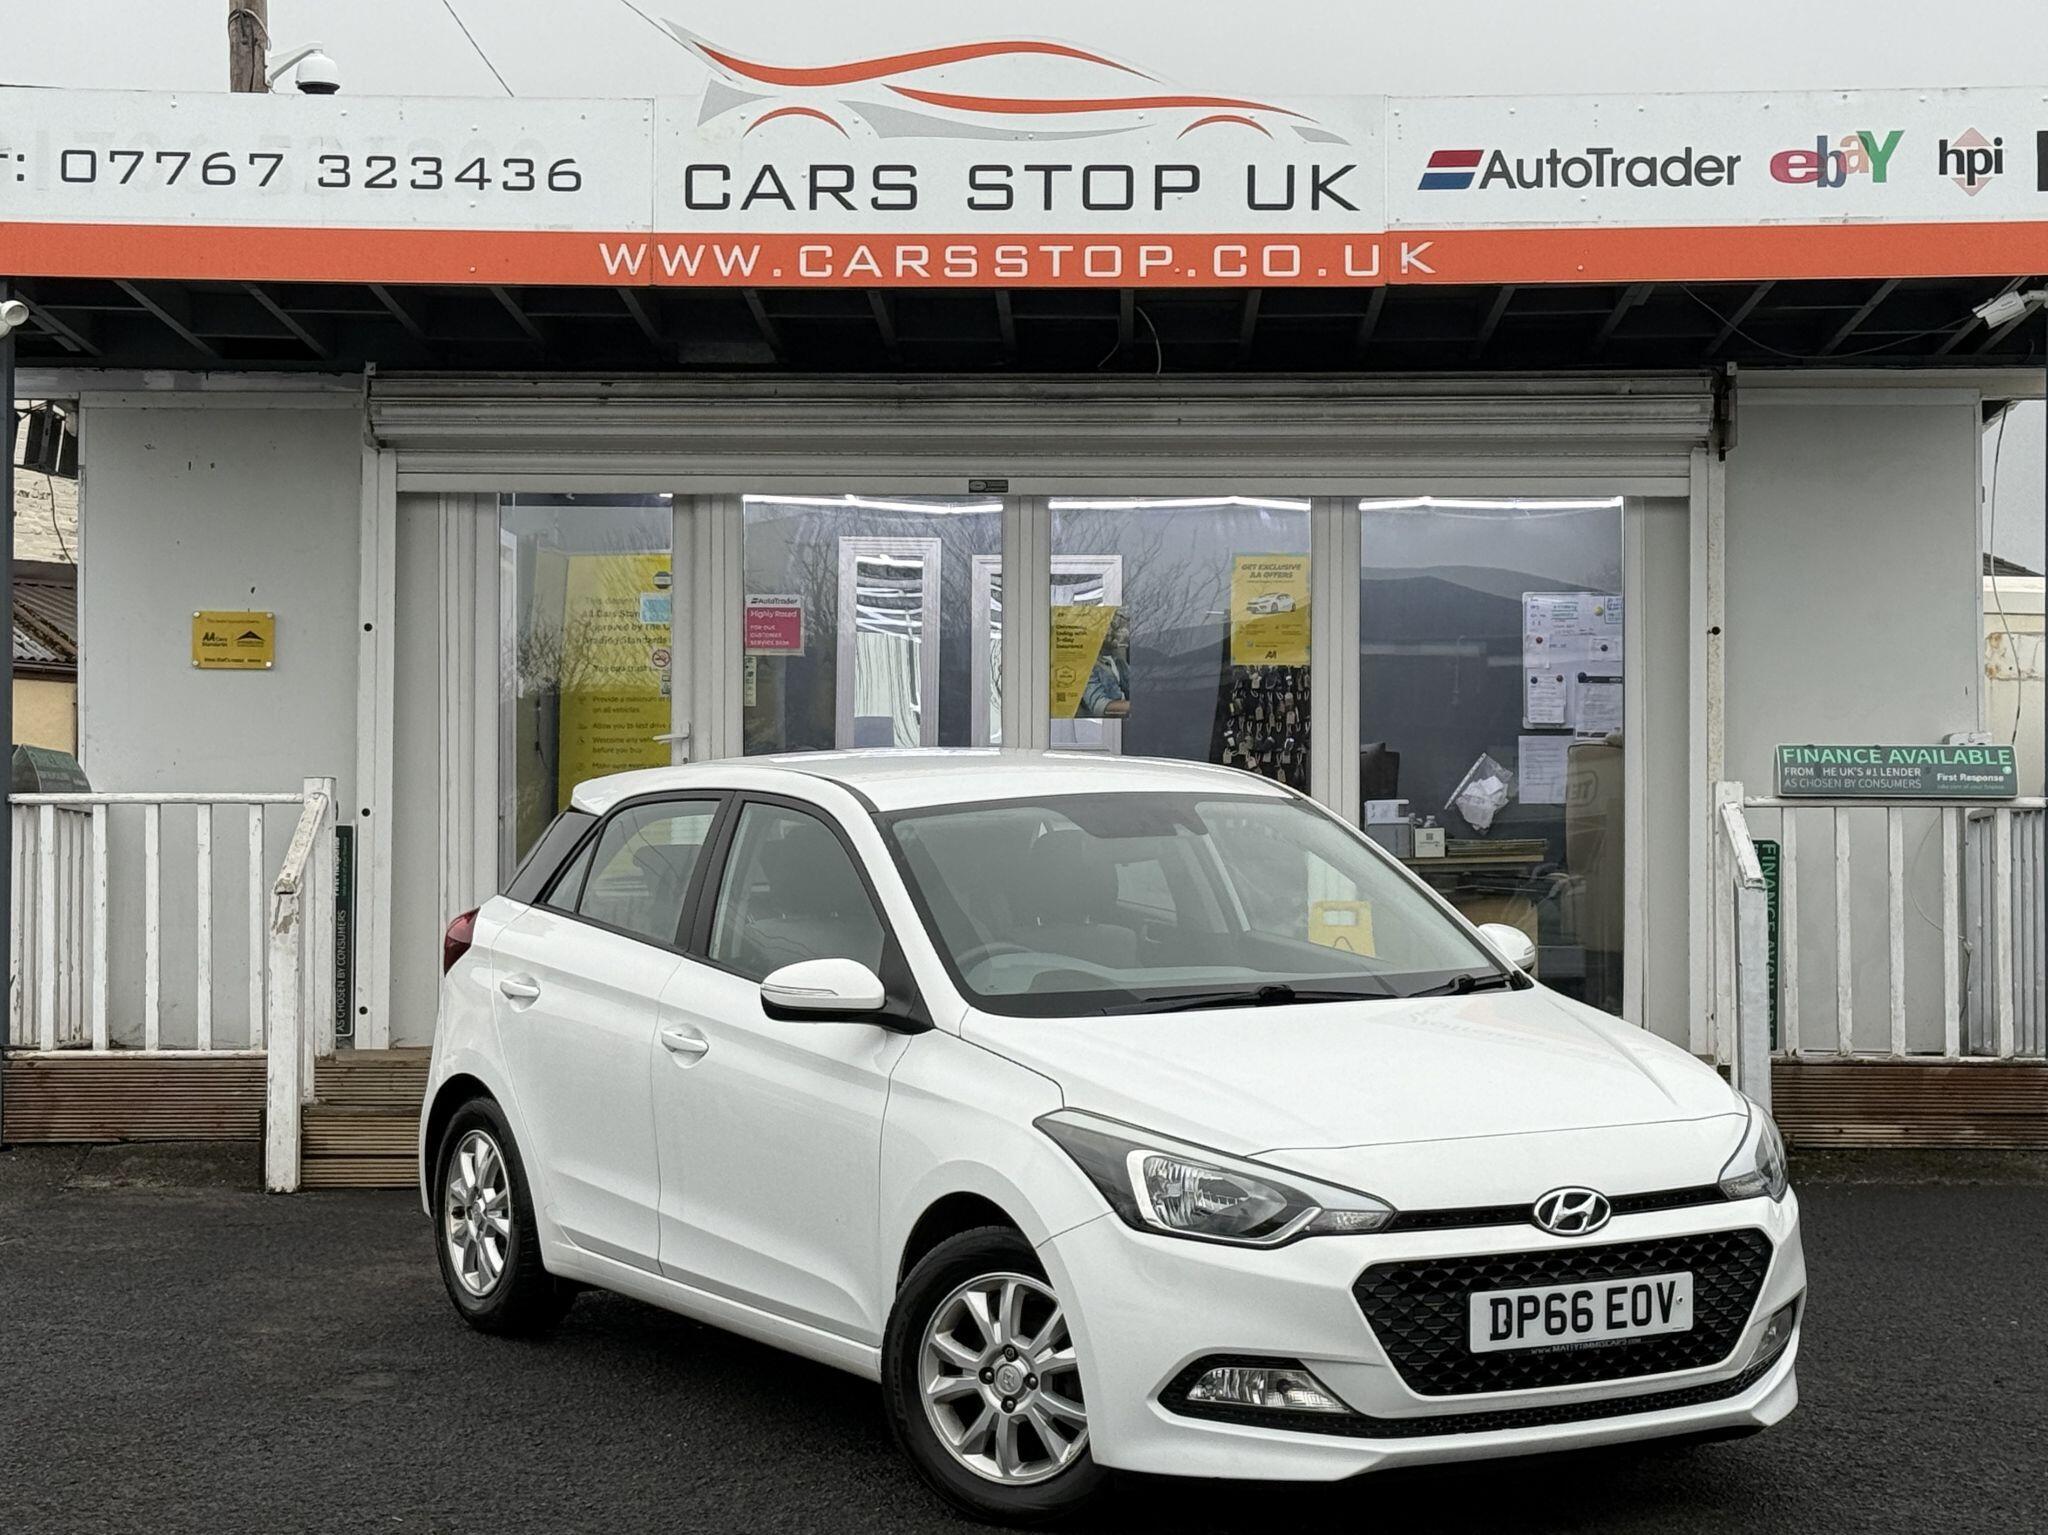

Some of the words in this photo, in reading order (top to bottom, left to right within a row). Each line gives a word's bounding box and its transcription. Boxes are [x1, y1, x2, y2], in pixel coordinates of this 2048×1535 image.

[60, 149, 285, 187] 07767
[317, 153, 583, 193] 323436
[1479, 146, 1742, 190] AutoTrader
[1938, 136, 2004, 186] hpi
[684, 163, 919, 212] CARS
[966, 164, 1201, 212] STOP
[1245, 163, 1361, 212] UK
[599, 240, 1437, 279] WWW.CARSSTOP.CO.UK
[1263, 571, 1294, 579] OFFERS
[1783, 747, 1884, 765] FINANCE
[1888, 748, 2012, 766] AVAILABLE
[1784, 767, 1815, 777] FROM
[1838, 767, 1865, 777] UK'S
[1865, 768, 1878, 777] #1
[1880, 767, 1922, 778] LENDER
[1784, 779, 1798, 788] AS
[1799, 779, 1843, 789] CHOSEN
[1844, 779, 1857, 788] BY
[1858, 779, 1922, 790] CONSUMERS
[1936, 773, 1958, 783] First
[1959, 773, 2005, 784] Response
[336, 909, 347, 966] CONSUMERS
[336, 967, 346, 979] BY
[336, 980, 346, 1018] CHOSEN
[337, 1019, 345, 1032] AS
[1490, 1289, 1594, 1342] DP66
[1605, 1279, 1678, 1331] EOV
